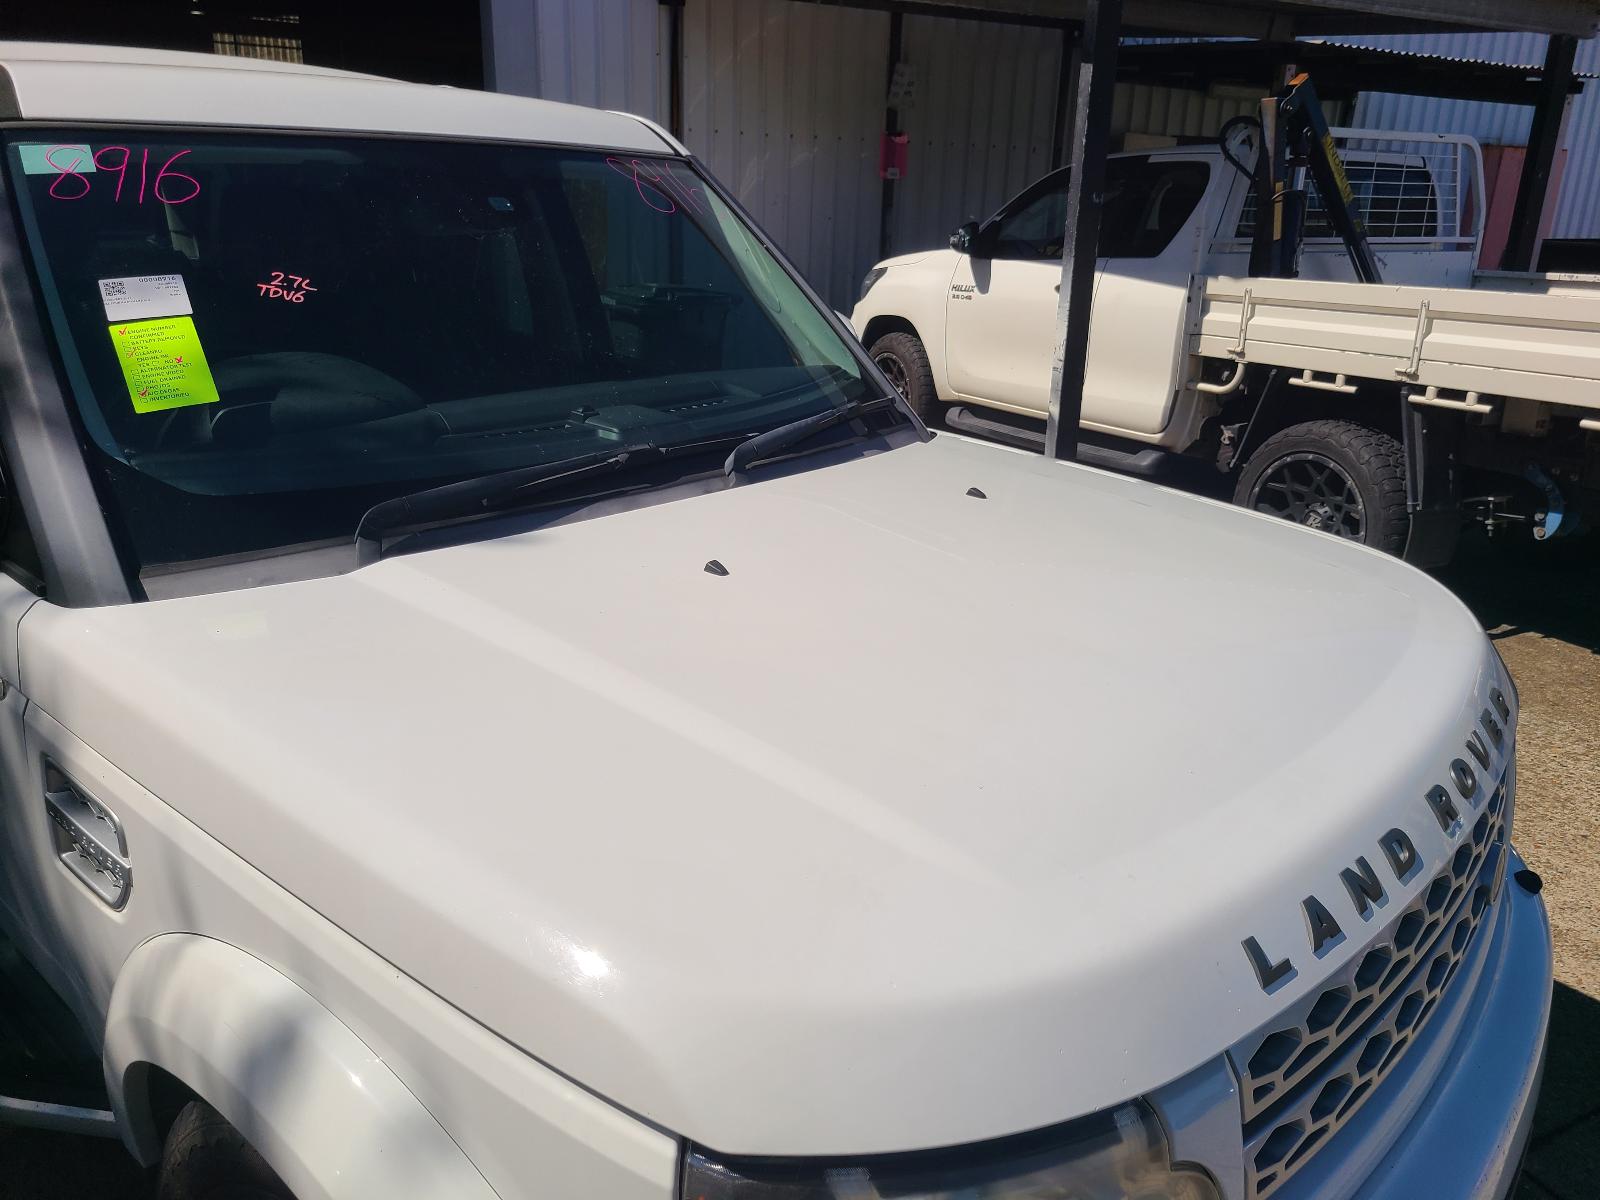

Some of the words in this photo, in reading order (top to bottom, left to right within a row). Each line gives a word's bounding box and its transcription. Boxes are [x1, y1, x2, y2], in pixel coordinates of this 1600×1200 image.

[45, 143, 201, 205] 8916
[271, 271, 318, 291] 2.7L
[951, 284, 976, 293] HILUX
[256, 284, 307, 303] TDV6
[1240, 827, 1417, 990] LAND
[1424, 686, 1511, 833] ROVER
